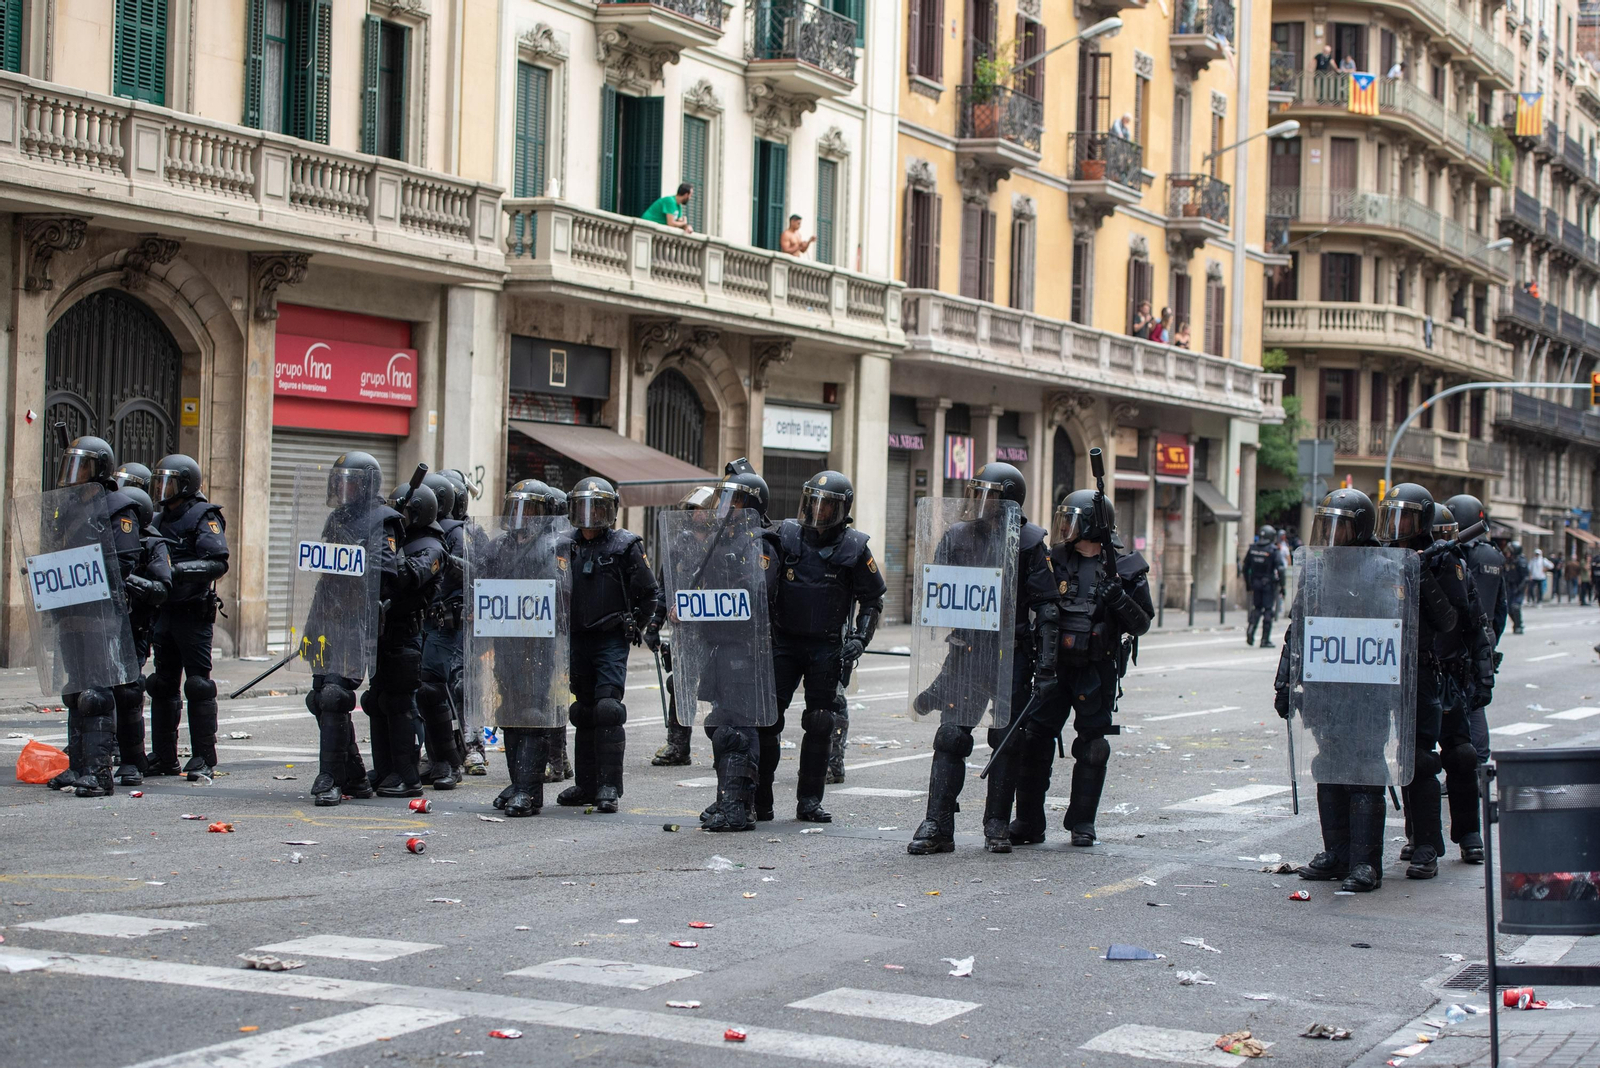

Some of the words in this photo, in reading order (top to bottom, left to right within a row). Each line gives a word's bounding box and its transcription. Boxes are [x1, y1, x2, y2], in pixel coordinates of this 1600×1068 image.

[275, 362, 302, 379] grupo
[310, 355, 332, 380] hna
[360, 372, 386, 388] grupo
[392, 365, 412, 388] hna
[278, 380, 297, 390] Seguros
[301, 382, 327, 392] Inversiones
[776, 420, 801, 436] centre
[299, 544, 363, 573] POLICIA
[33, 560, 104, 595] POLICIA
[478, 595, 552, 620] POLICIA
[677, 592, 750, 617] POLICIA
[926, 582, 997, 613] POLICIA
[1309, 635, 1397, 666] POLICIA
